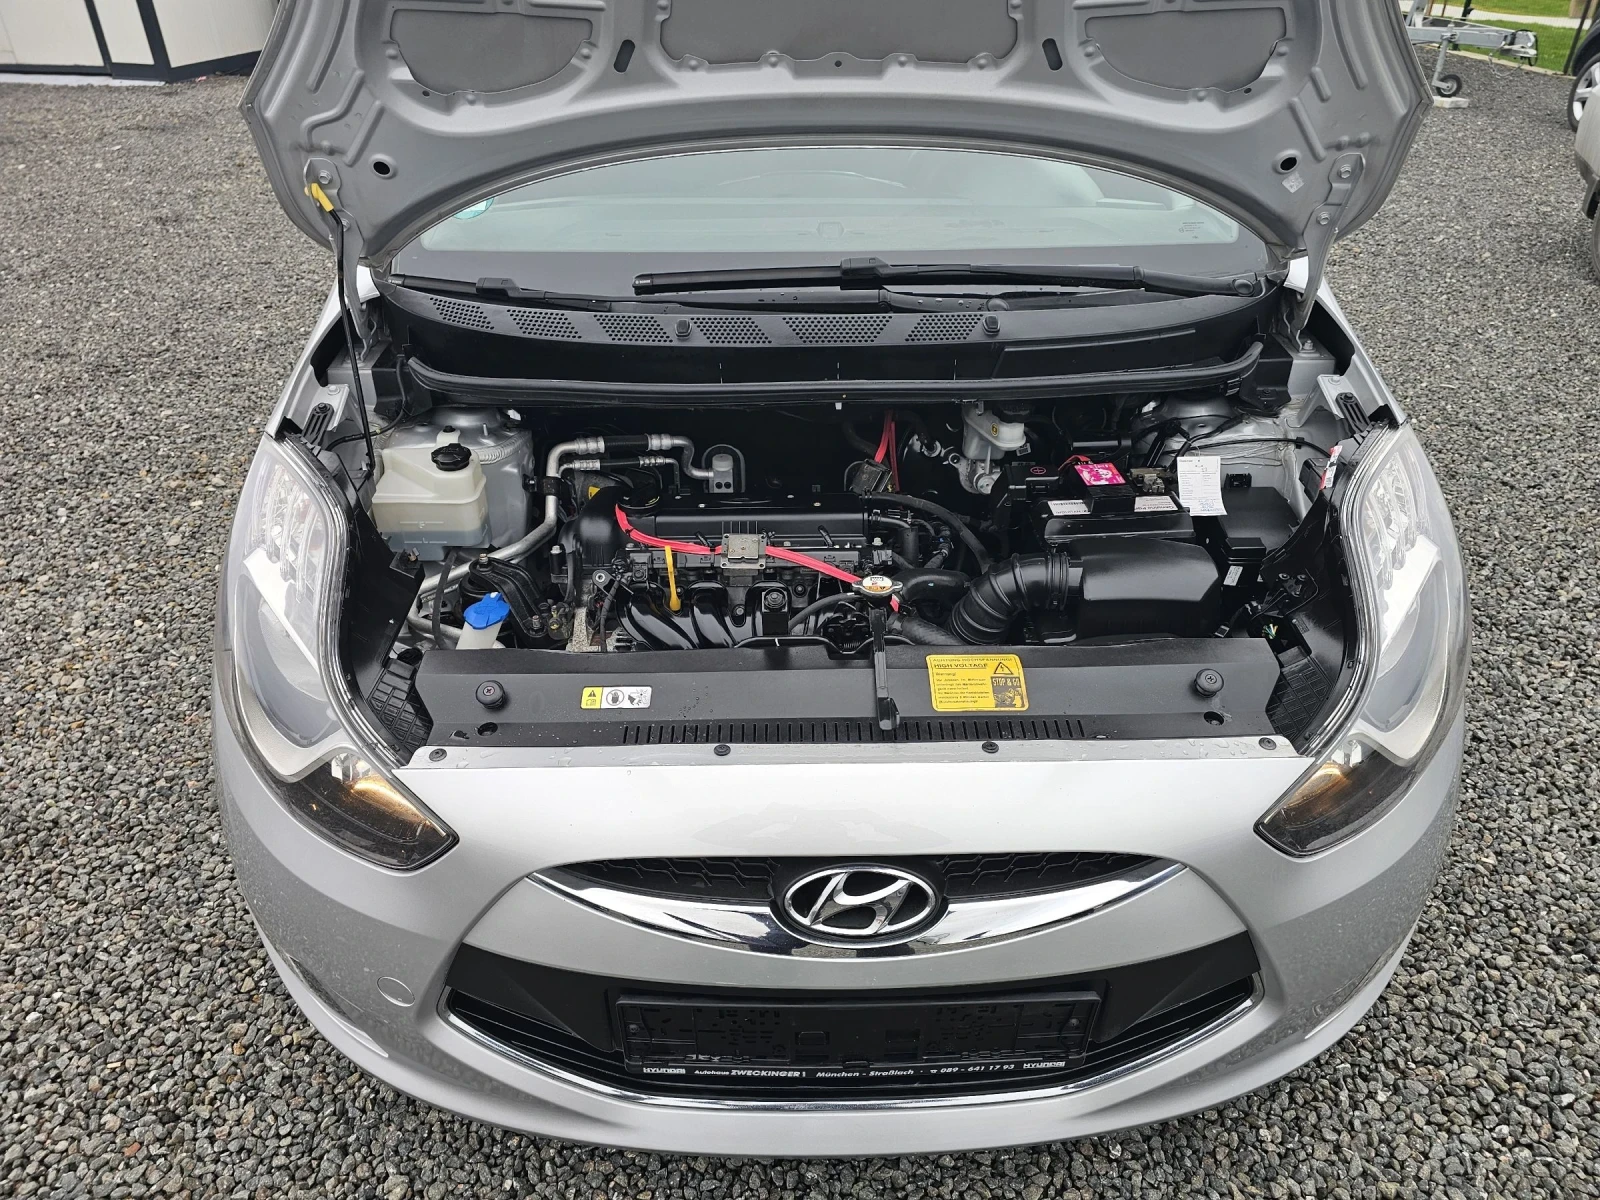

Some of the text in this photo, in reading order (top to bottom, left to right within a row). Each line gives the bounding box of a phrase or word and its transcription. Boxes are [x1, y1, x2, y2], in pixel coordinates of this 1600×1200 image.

[992, 678, 1006, 686] STOP
[1007, 678, 1012, 686] &
[1013, 678, 1020, 686] GO
[1023, 1061, 1066, 1069] HYUNDAI
[731, 1069, 801, 1077] ZWECKINGER
[869, 1069, 914, 1077] Straßlach
